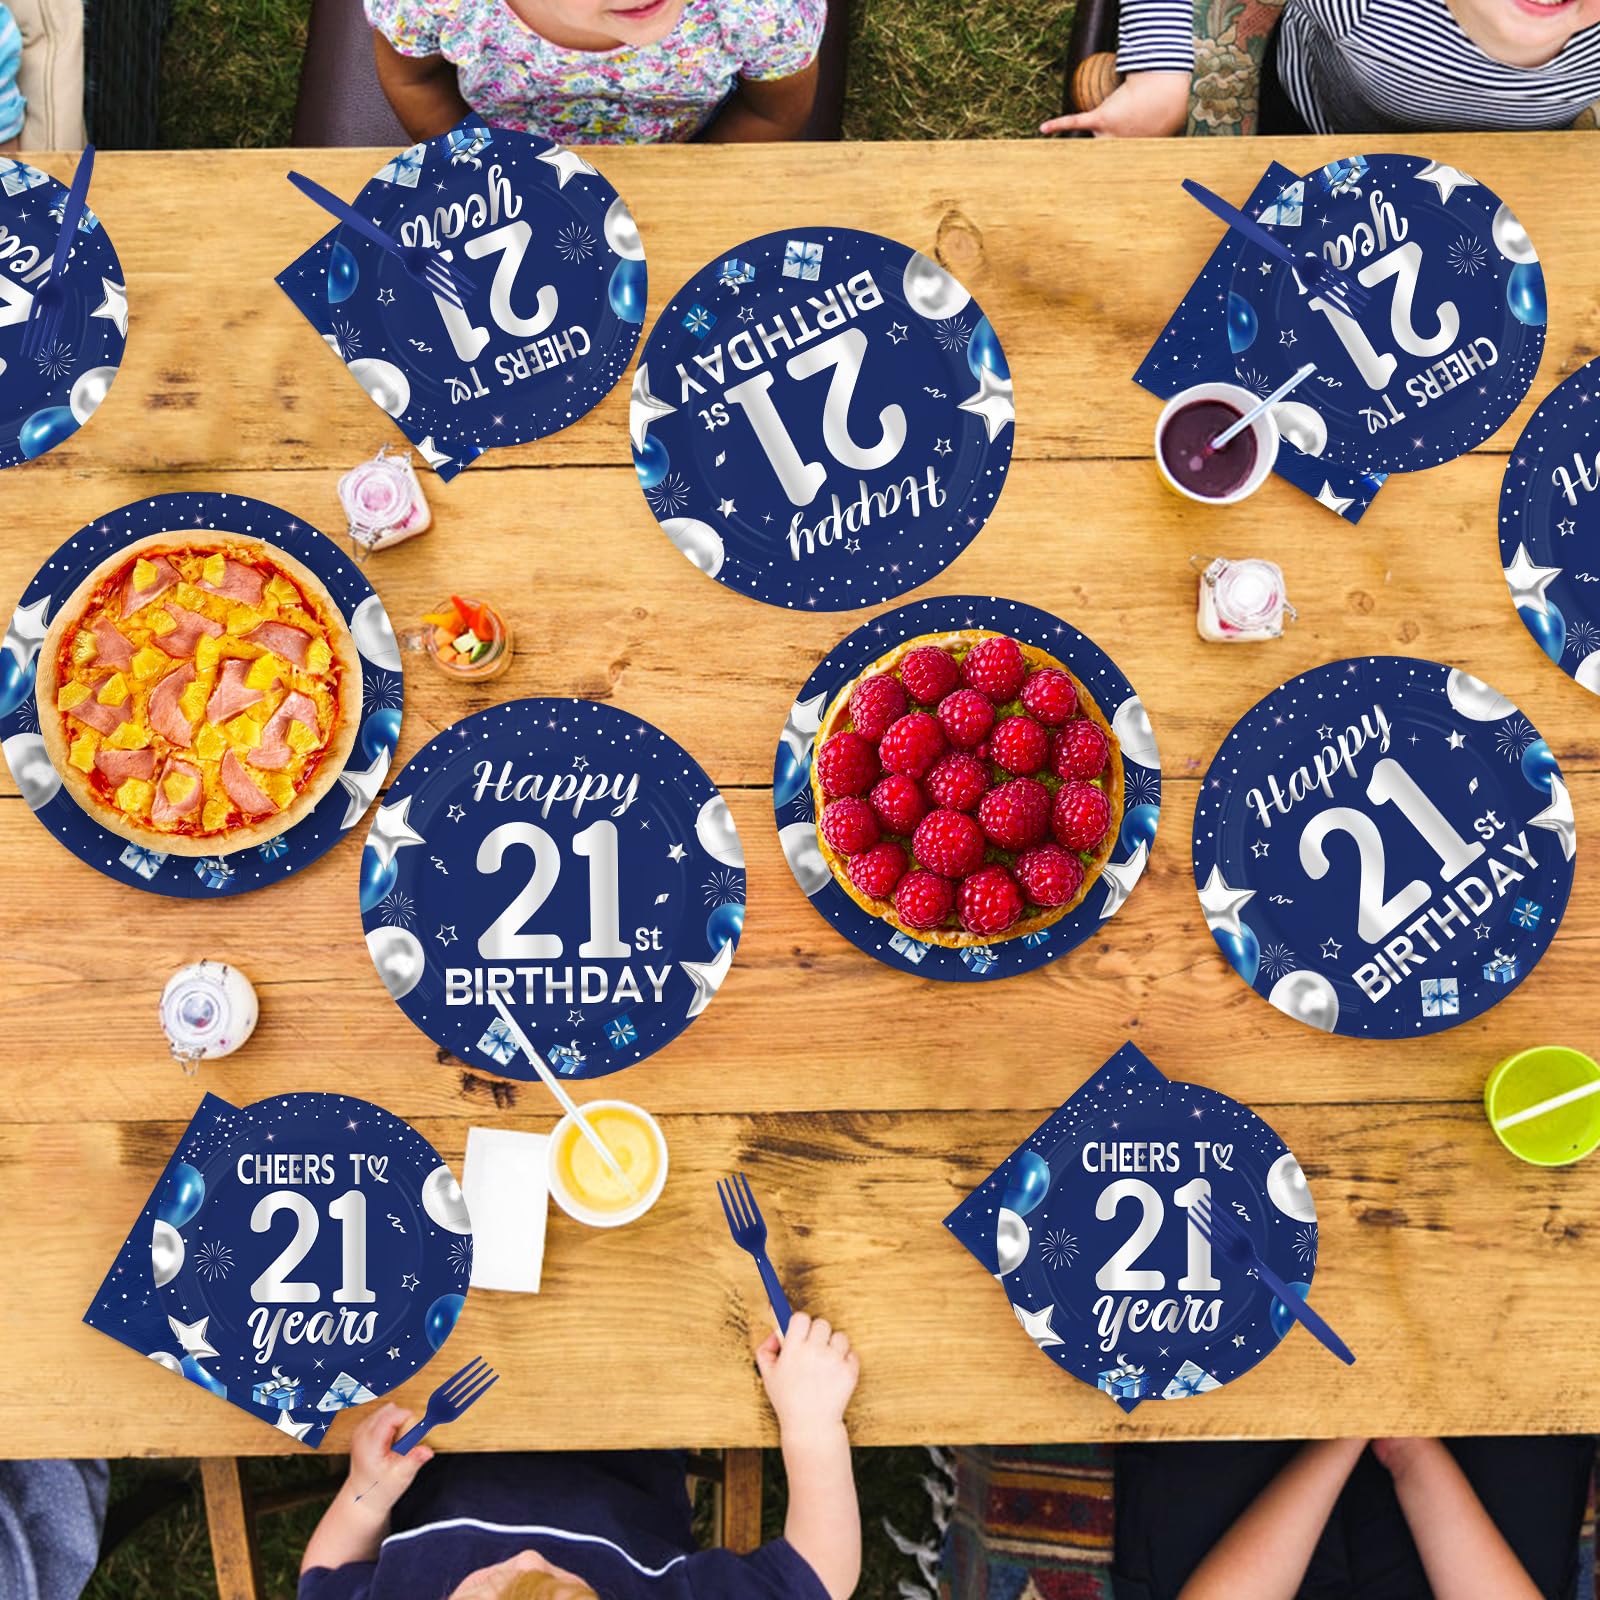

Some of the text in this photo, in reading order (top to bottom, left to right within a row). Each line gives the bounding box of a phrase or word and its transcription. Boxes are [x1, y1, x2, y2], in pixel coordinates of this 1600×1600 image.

[424, 220, 559, 362] 21
[675, 269, 885, 404] BIRTHDAY
[1308, 241, 1460, 391] 21
[495, 325, 591, 386] CHEERS
[1405, 337, 1498, 408] CHEERS
[785, 466, 947, 561] Happy
[472, 760, 640, 820] Happy
[1245, 704, 1392, 828] Happy
[1351, 831, 1539, 1004] BIRTHDAY
[445, 965, 672, 1006] BIRTHDAY
[237, 1153, 335, 1185] CHEERS
[1082, 1141, 1180, 1173] CHEERS
[250, 1189, 376, 1303] 21
[1095, 1178, 1221, 1291] 21
